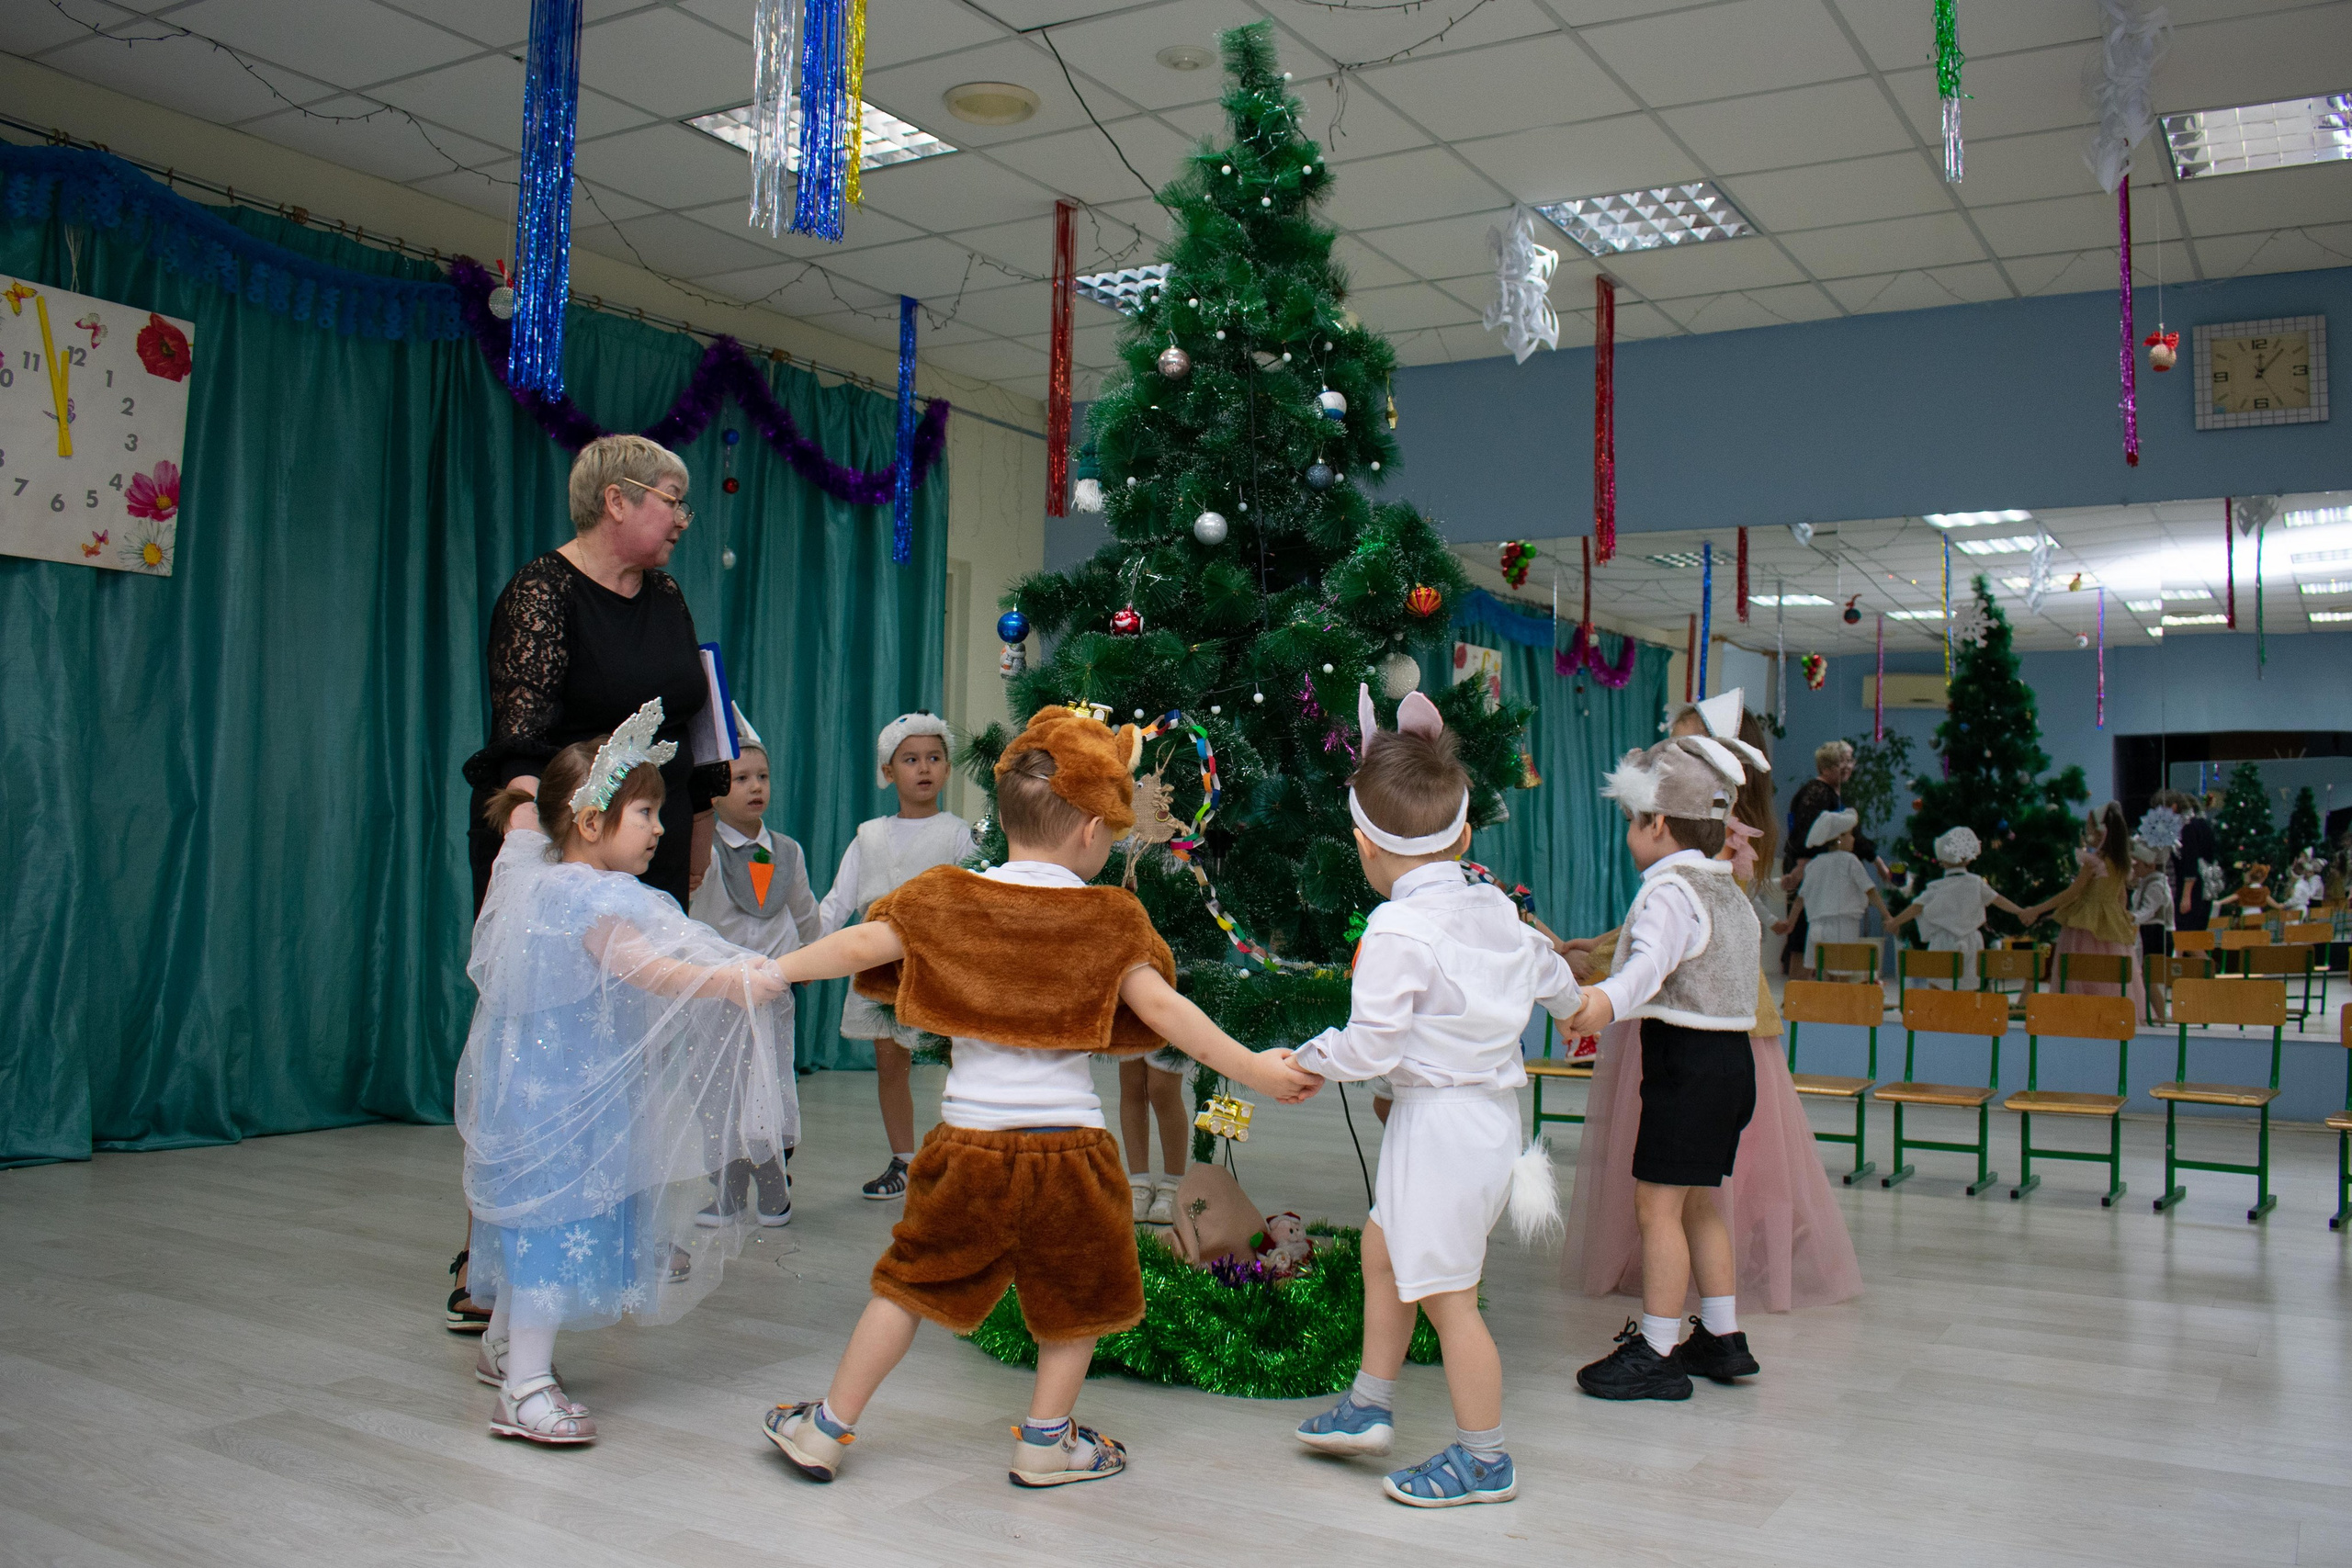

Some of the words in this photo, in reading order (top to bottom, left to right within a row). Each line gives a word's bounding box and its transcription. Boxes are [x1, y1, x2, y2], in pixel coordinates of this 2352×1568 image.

[2252, 339, 2267, 350] 12
[23, 351, 40, 372] 11
[68, 345, 86, 367] 12
[0, 368, 14, 388] 0
[106, 369, 113, 388] 1
[2213, 371, 2228, 382] 9
[2293, 365, 2308, 376] 3
[120, 397, 135, 416] 2
[2254, 398, 2268, 409] 6
[125, 434, 138, 452] 3
[14, 478, 29, 496] 7
[108, 473, 123, 491] 4
[51, 493, 65, 512] 6
[86, 490, 98, 508] 5
